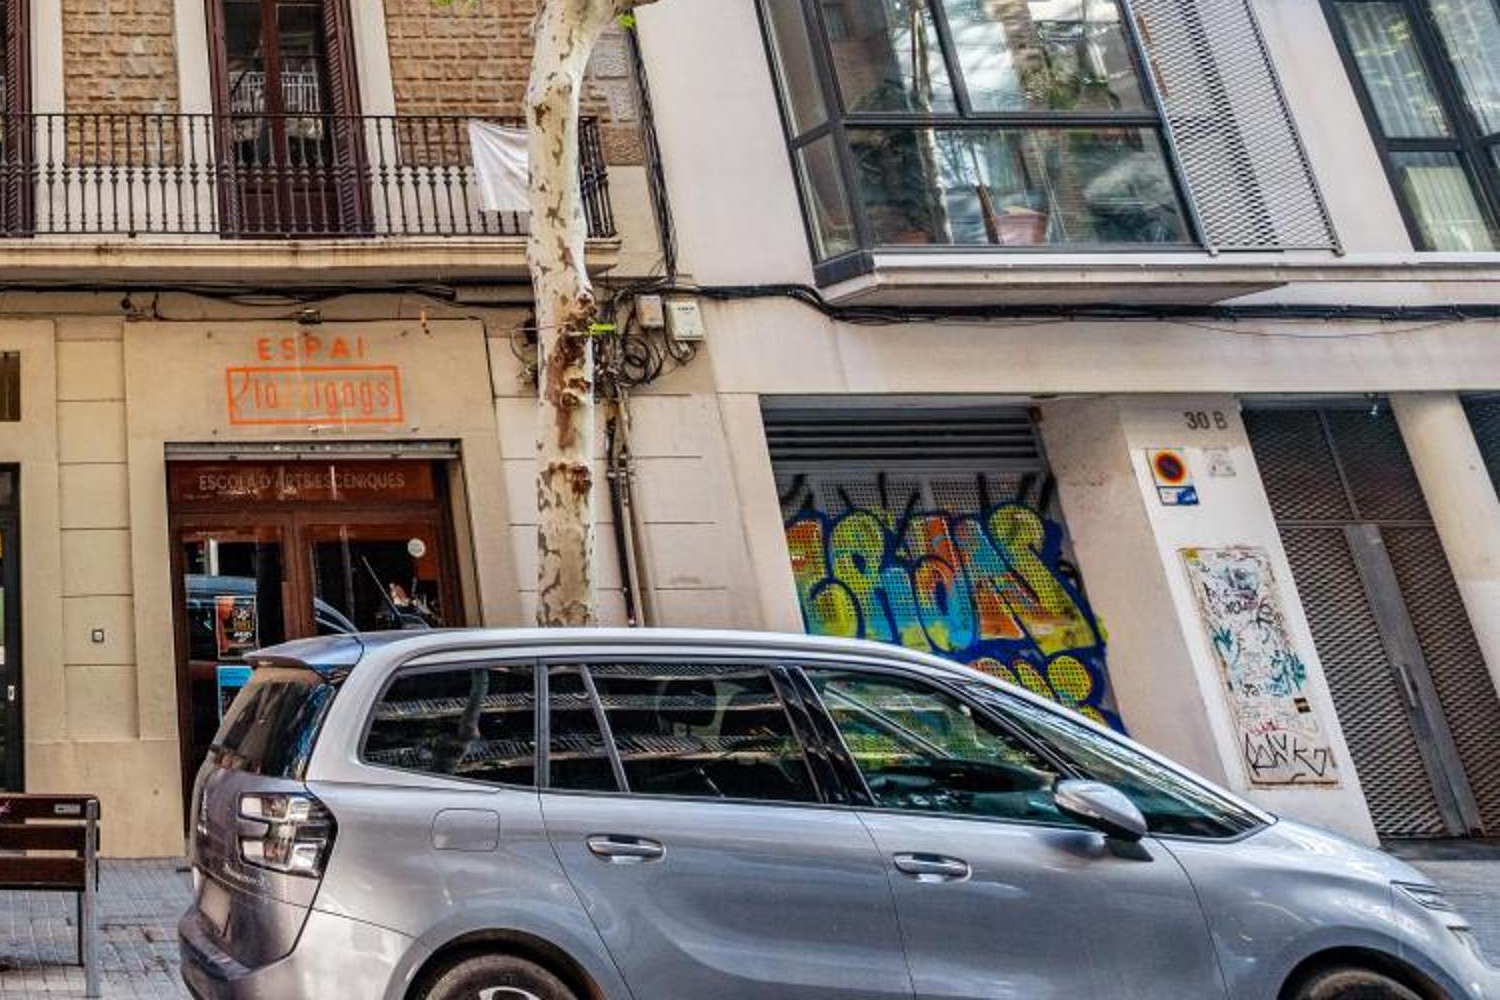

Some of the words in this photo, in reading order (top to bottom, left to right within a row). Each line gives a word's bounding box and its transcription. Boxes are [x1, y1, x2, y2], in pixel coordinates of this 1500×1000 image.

[258, 334, 366, 361] ESPAI
[1184, 411, 1210, 430] 30
[1213, 411, 1229, 430] B
[200, 474, 257, 491] ESCOLA
